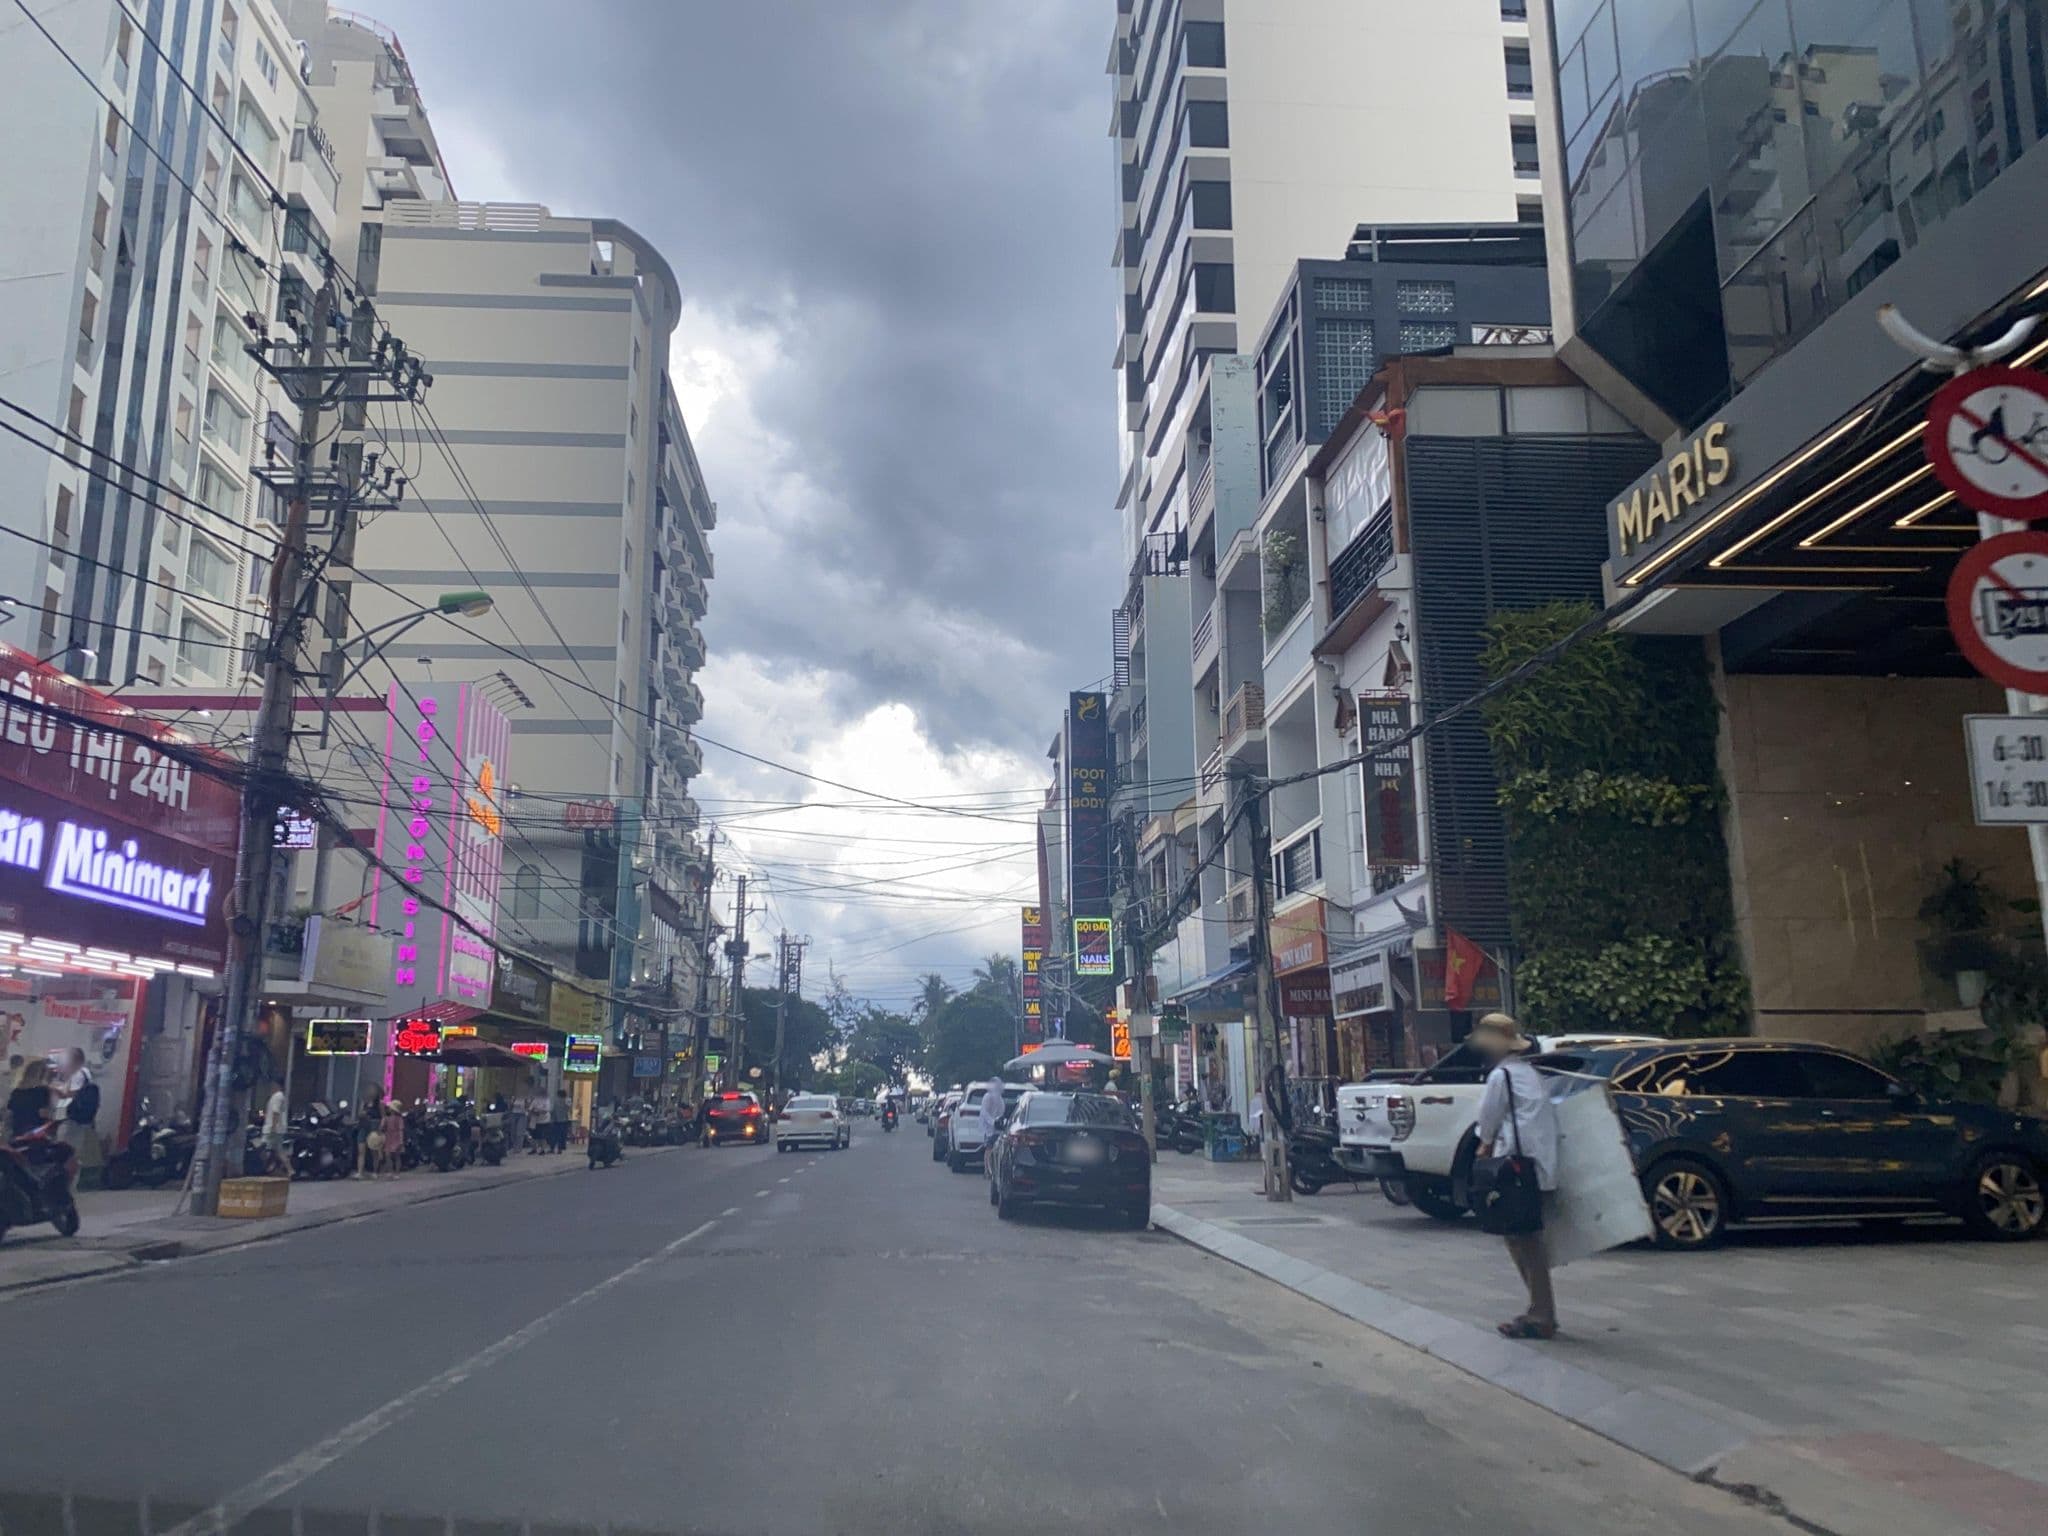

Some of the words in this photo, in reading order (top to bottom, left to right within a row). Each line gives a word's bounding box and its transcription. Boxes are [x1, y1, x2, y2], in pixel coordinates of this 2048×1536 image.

[1617, 422, 1729, 556] MARIS
[1371, 708, 1399, 725] NHÀ
[1366, 745, 1410, 759] ANH
[131, 745, 192, 812] 24H
[1072, 768, 1106, 780] FOOT
[1081, 781, 1097, 794] &
[1072, 797, 1106, 809] BODY
[46, 822, 211, 918] Minimart
[1080, 953, 1111, 965] NAILS
[398, 1030, 439, 1054] Spa
